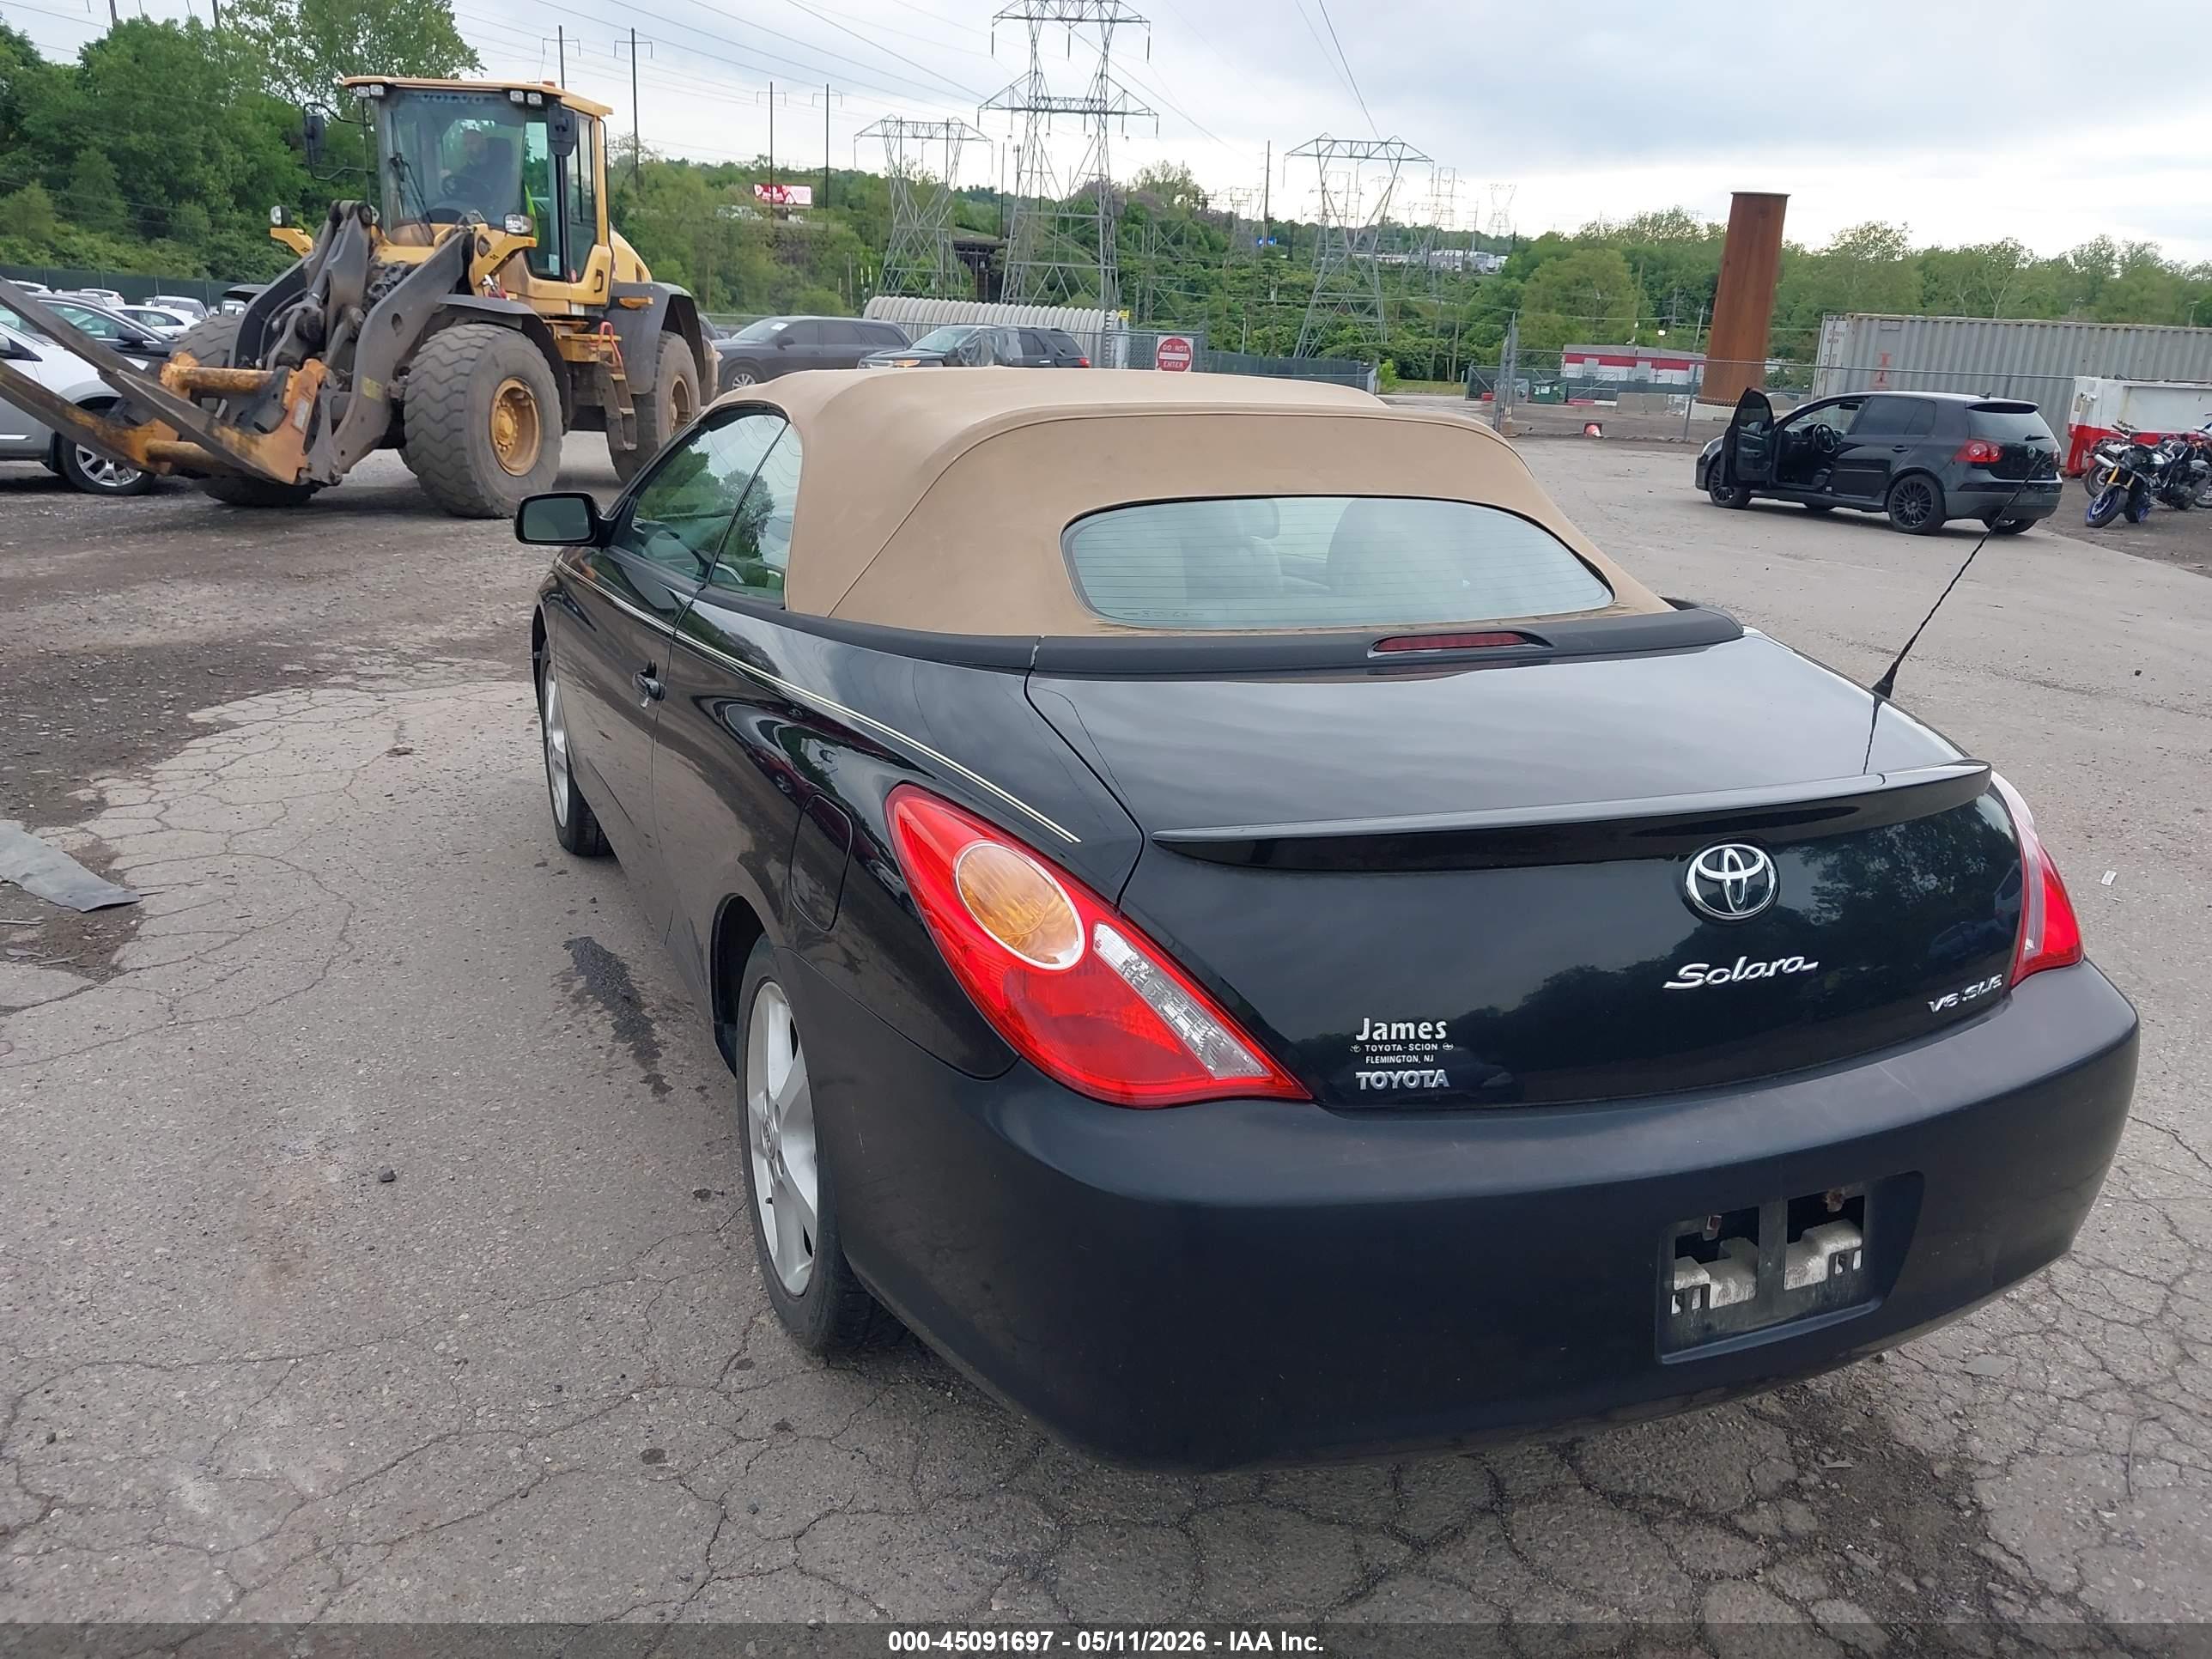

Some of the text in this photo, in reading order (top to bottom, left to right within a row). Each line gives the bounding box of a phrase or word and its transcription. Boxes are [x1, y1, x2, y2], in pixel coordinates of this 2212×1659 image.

[1662, 956, 1819, 989] Solara
[1927, 974, 2002, 1012] V6 SLE
[1355, 1018, 1447, 1041] James
[1364, 1042, 1438, 1053] TOYOTA-SCION
[1365, 1054, 1434, 1064] FLEMINGTON, NJ
[1355, 1069, 1450, 1091] TOYOTA
